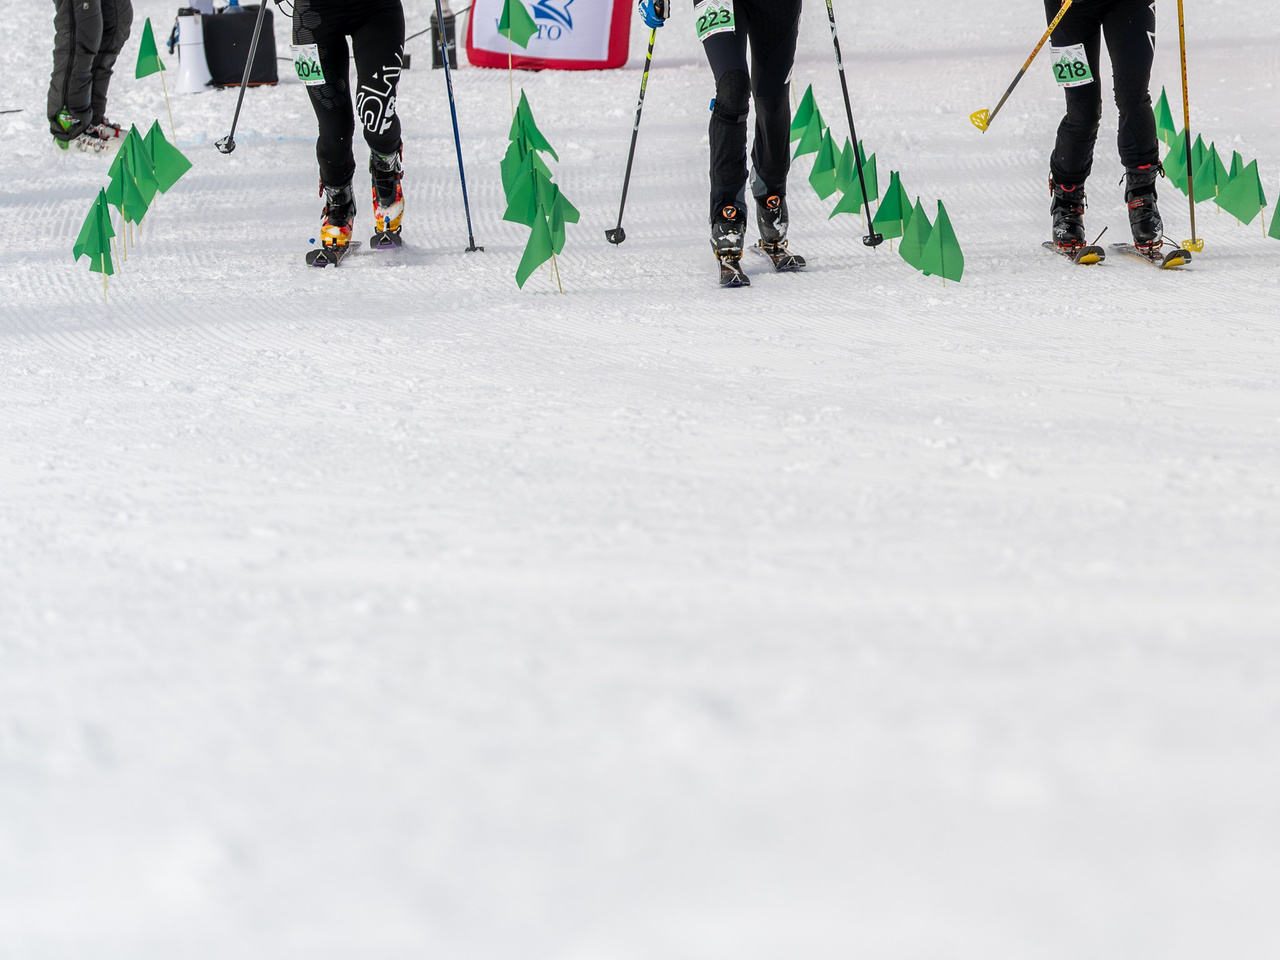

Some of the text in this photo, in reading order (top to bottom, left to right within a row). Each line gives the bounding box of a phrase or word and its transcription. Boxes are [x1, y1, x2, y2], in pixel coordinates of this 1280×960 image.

[698, 9, 731, 33] 223
[294, 60, 321, 78] 204
[1055, 60, 1087, 79] 218
